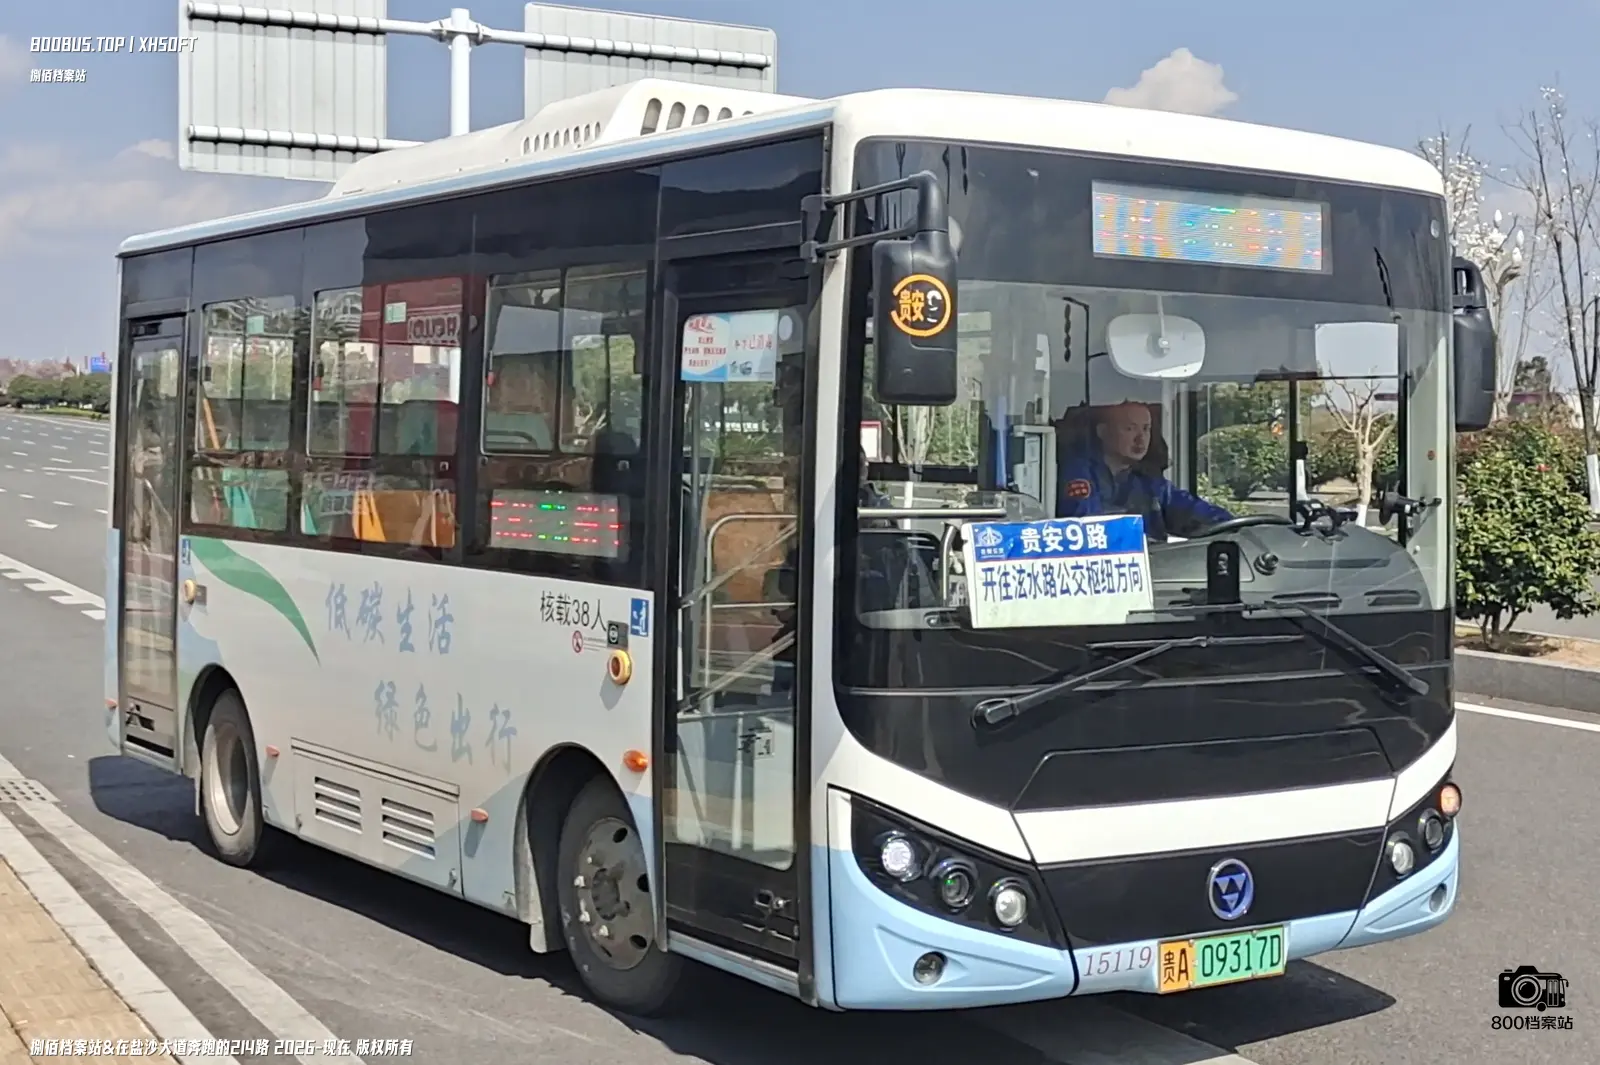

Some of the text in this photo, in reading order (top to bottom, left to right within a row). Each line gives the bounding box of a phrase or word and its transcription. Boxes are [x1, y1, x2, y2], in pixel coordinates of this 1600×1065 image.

[1020, 523, 1108, 554] 贵安9路
[325, 581, 454, 655] 低碳生活
[540, 590, 607, 632] 核载38人
[374, 680, 518, 775] 绿色出行
[1083, 946, 1152, 977] 15119
